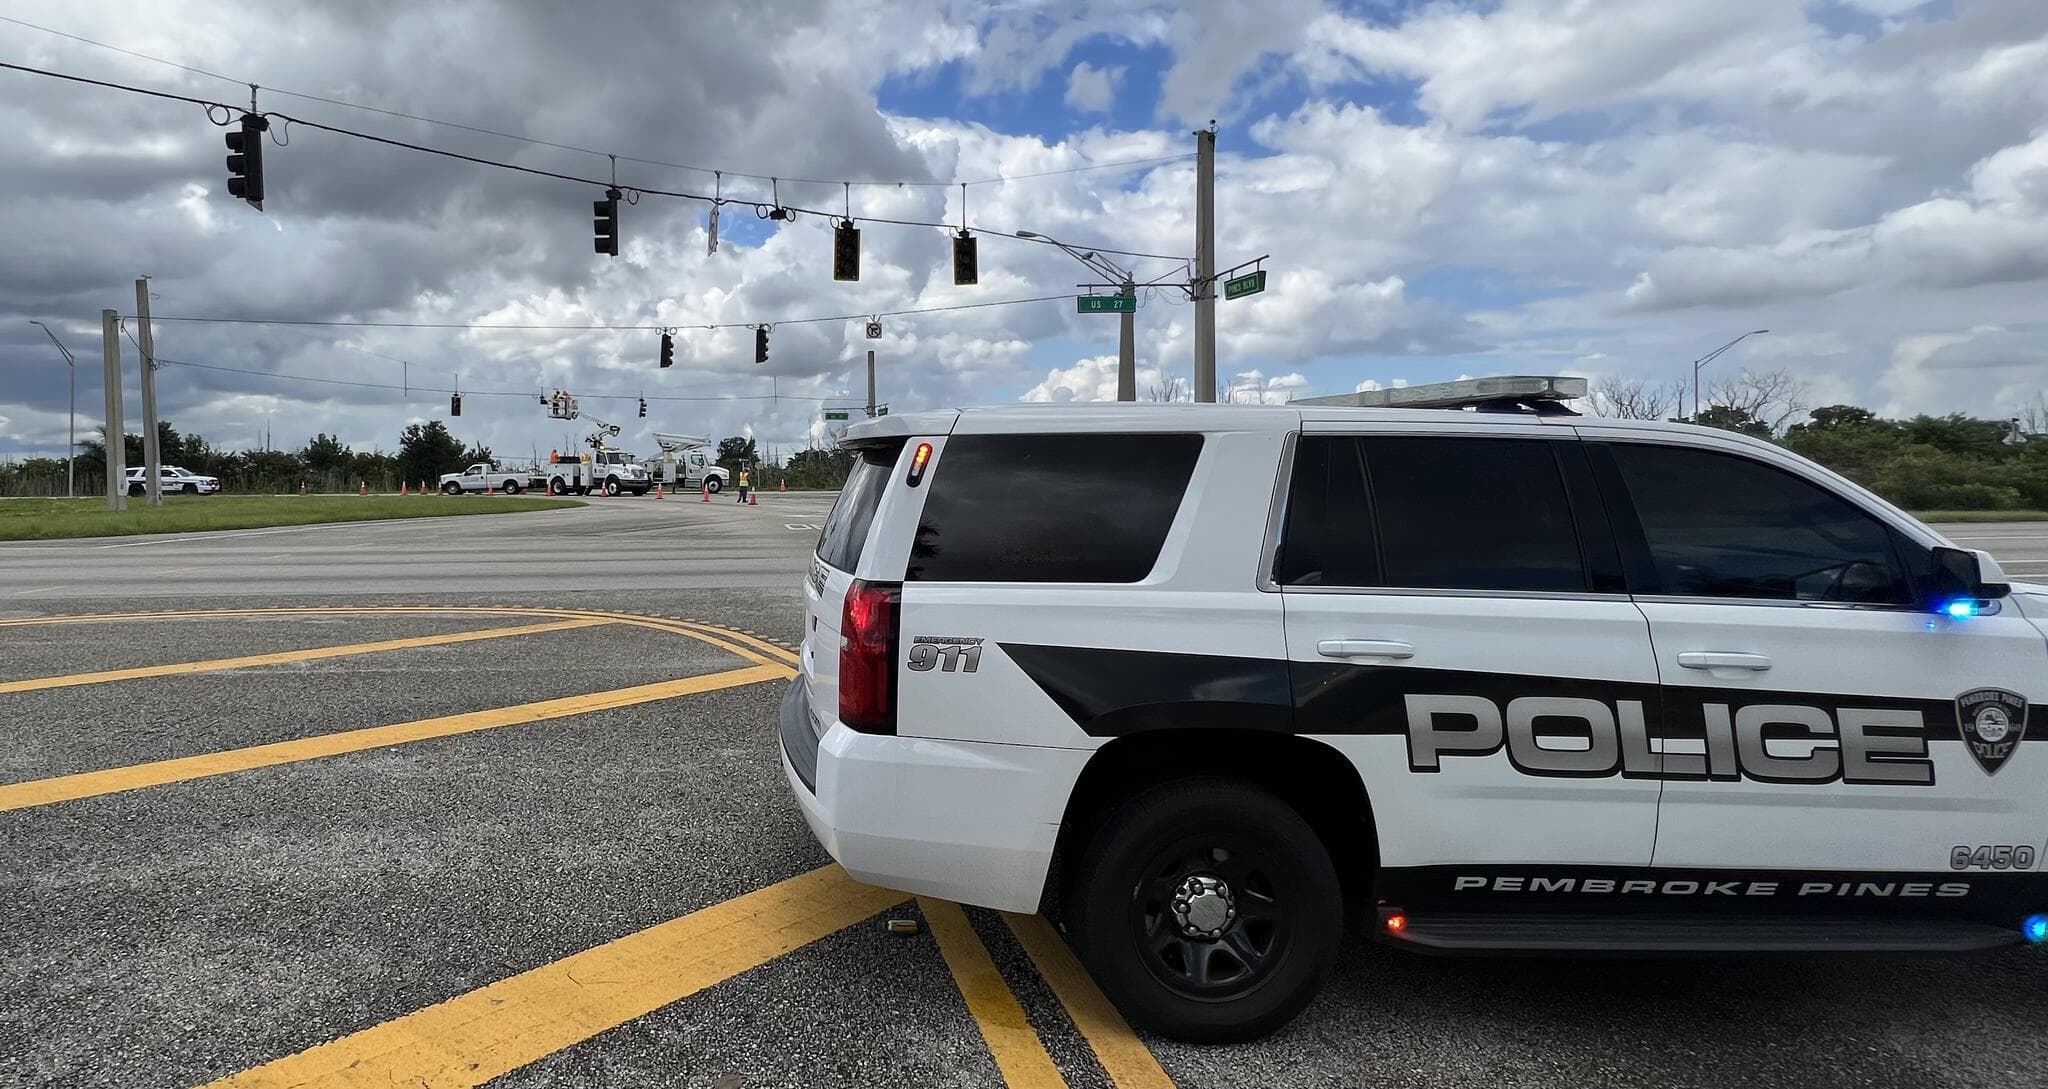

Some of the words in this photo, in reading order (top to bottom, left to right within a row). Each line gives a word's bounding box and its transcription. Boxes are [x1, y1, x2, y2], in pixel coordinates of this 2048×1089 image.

[1090, 300, 1102, 309] US
[1113, 300, 1123, 309] 27
[913, 635, 984, 645] EMERGENCY
[907, 644, 982, 672] 911
[1403, 694, 1936, 787] POLICE
[1972, 741, 2013, 758] POLICE
[1950, 845, 2035, 870] 6450
[1454, 877, 1779, 896] PEMBROKE
[1798, 882, 1971, 897] PINES
